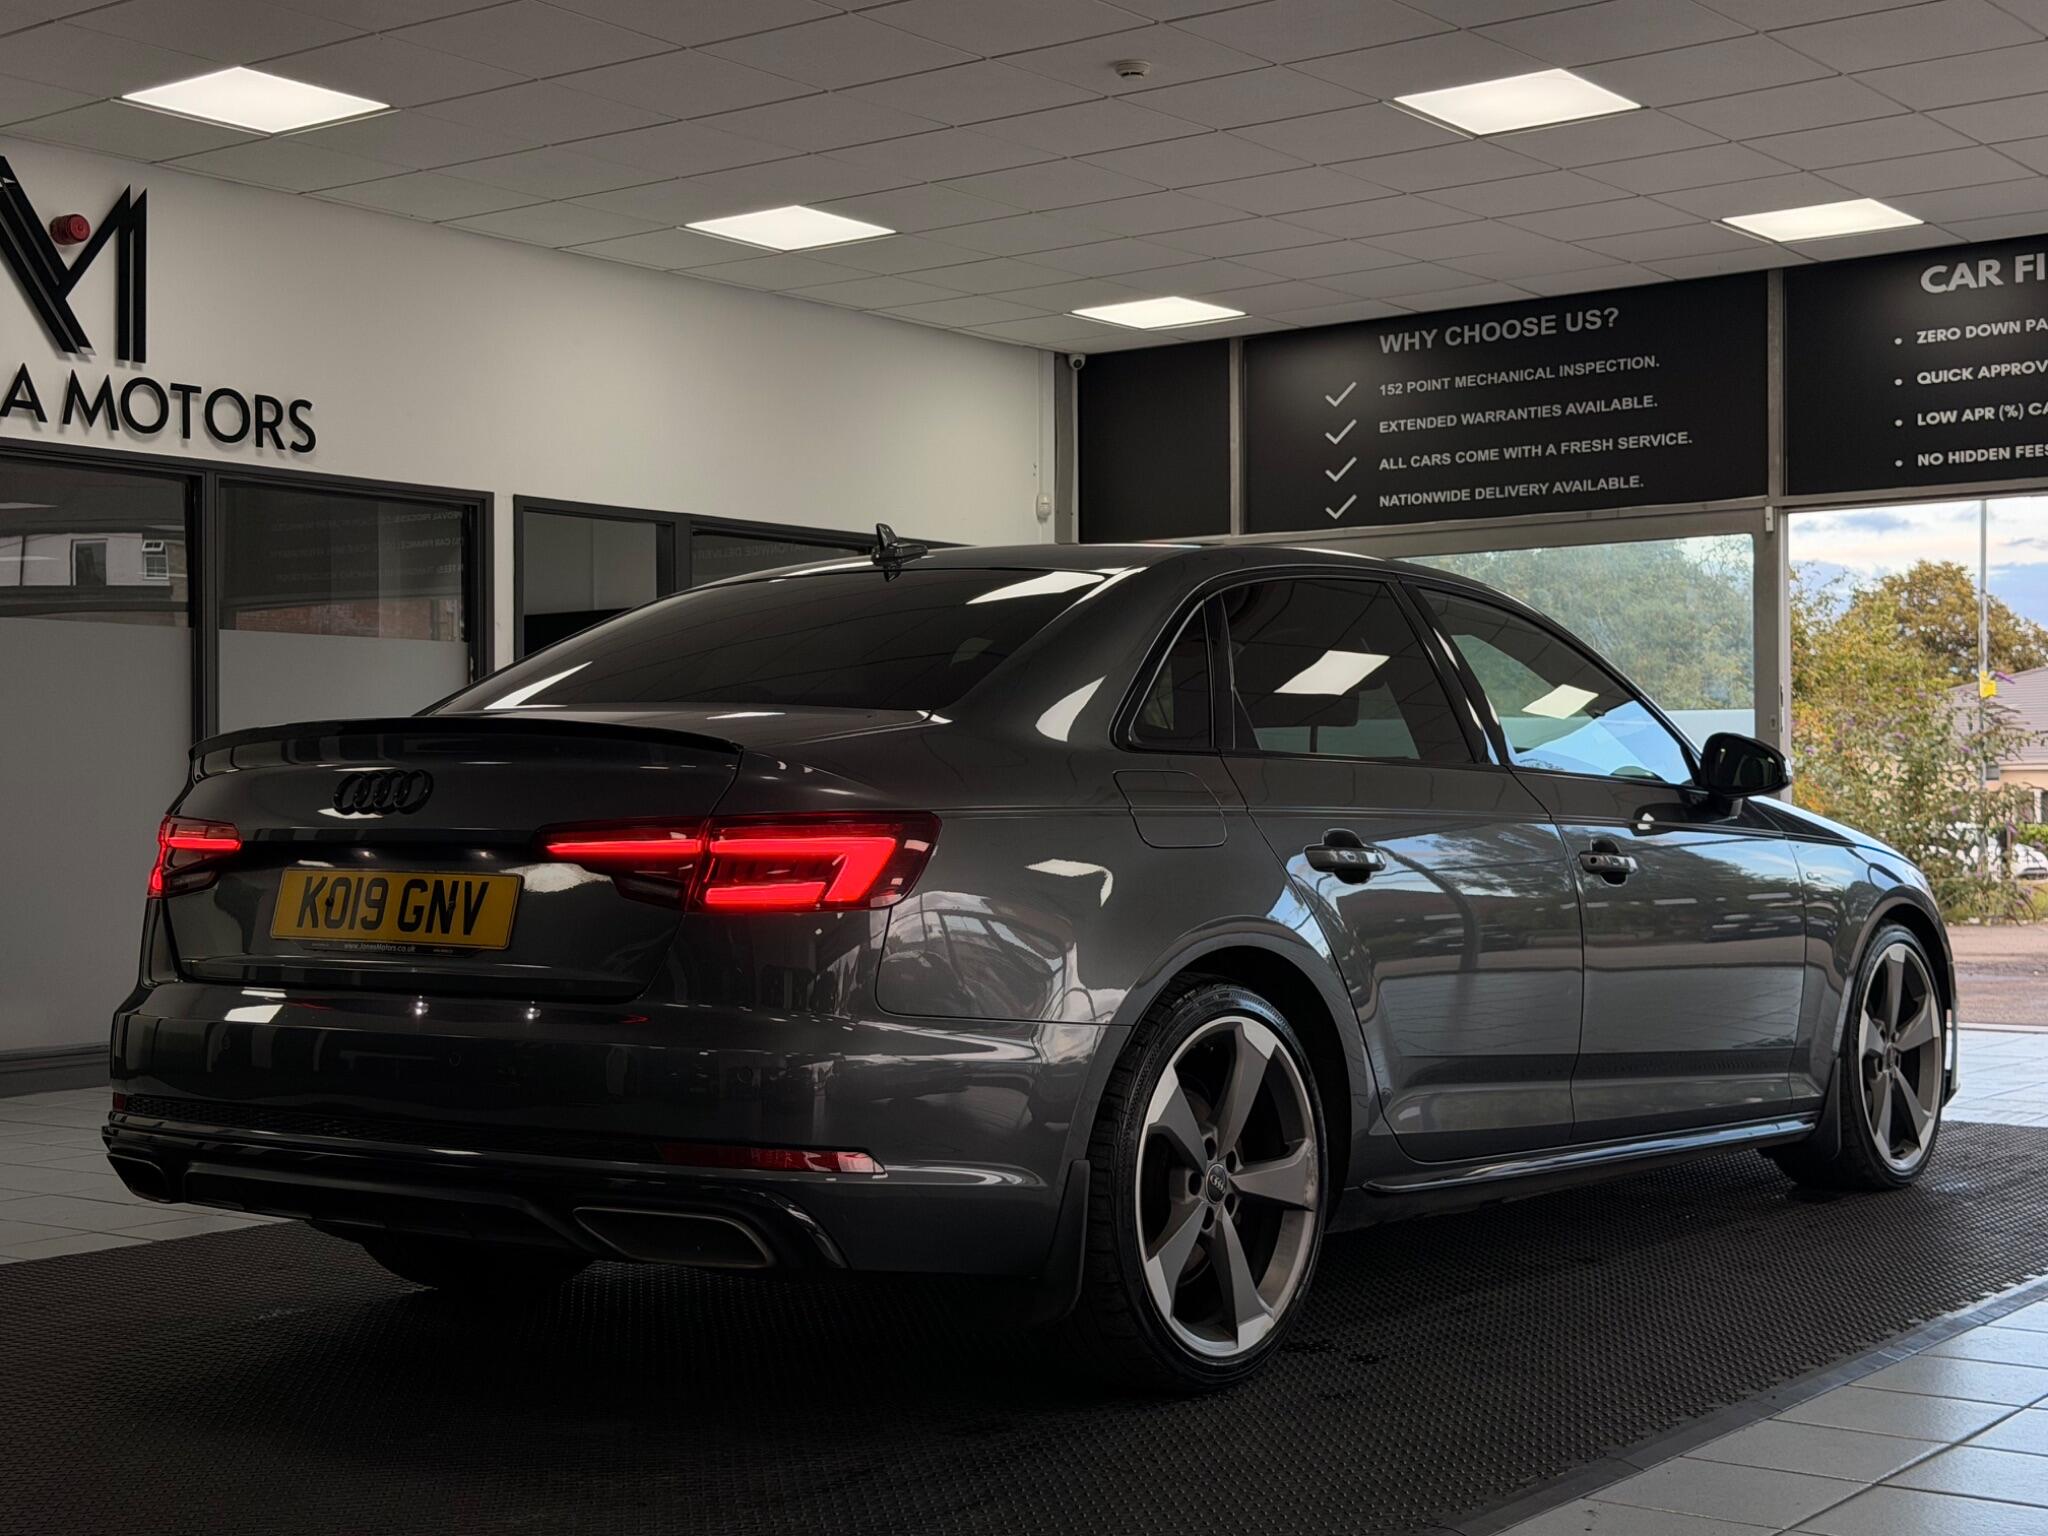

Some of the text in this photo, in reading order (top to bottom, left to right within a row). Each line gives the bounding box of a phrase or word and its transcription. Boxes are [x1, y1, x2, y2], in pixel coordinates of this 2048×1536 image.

[1921, 252, 2046, 294] CAR FI
[1379, 307, 1619, 354] WHY CHOOSE US?
[1916, 317, 2048, 344] ZERO DOWN PA
[1379, 355, 1660, 396] 152 POINT MECHANICAL INSPECTION.
[1916, 360, 2048, 385] QUICK APPROV
[62, 369, 317, 453] MOTORS
[1379, 395, 1658, 434] EXTENDED WARRANTIES AVAILABLE.
[1916, 410, 1958, 426] LOW
[1961, 407, 1995, 422] APR
[1999, 403, 2024, 422] (%)
[1379, 431, 1693, 471] ALL CARS COME WITH A FRESH SERVICE.
[1916, 453, 1944, 467] NO
[1948, 446, 2010, 464] HIDDEN
[1379, 475, 1645, 507] NATIONWIDE DELIVERY AVAILABLE.
[296, 875, 489, 936] KO19 GNV
